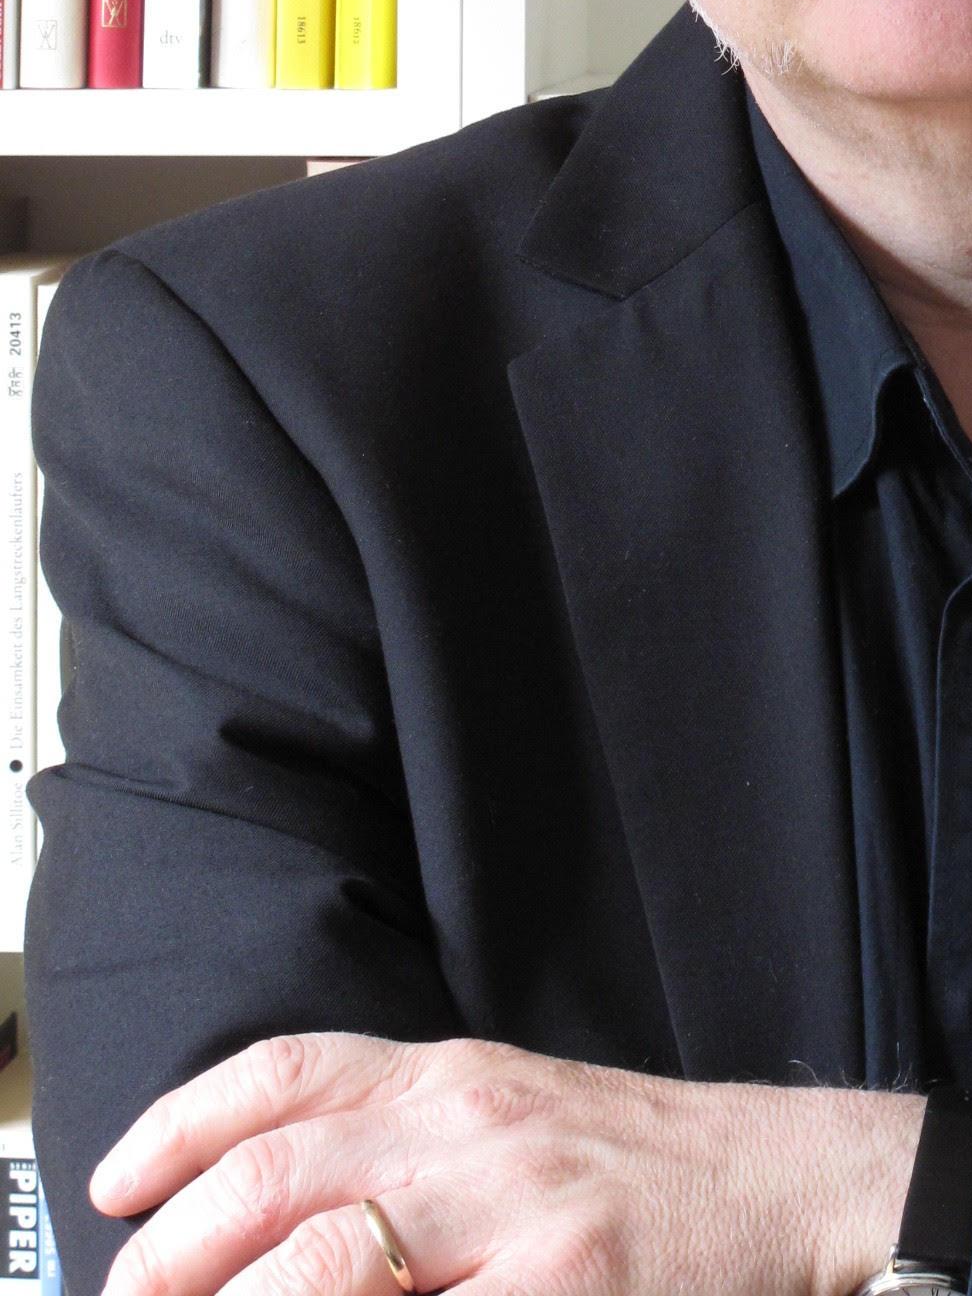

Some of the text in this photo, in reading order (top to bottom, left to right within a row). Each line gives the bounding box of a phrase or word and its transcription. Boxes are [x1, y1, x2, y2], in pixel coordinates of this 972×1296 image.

[296, 15, 307, 45] 18613
[9, 312, 22, 357] 20413
[10, 617, 24, 639] des
[10, 644, 24, 721] Einsamkeit
[10, 724, 23, 750] Die
[8, 1170, 38, 1275] PIPER
